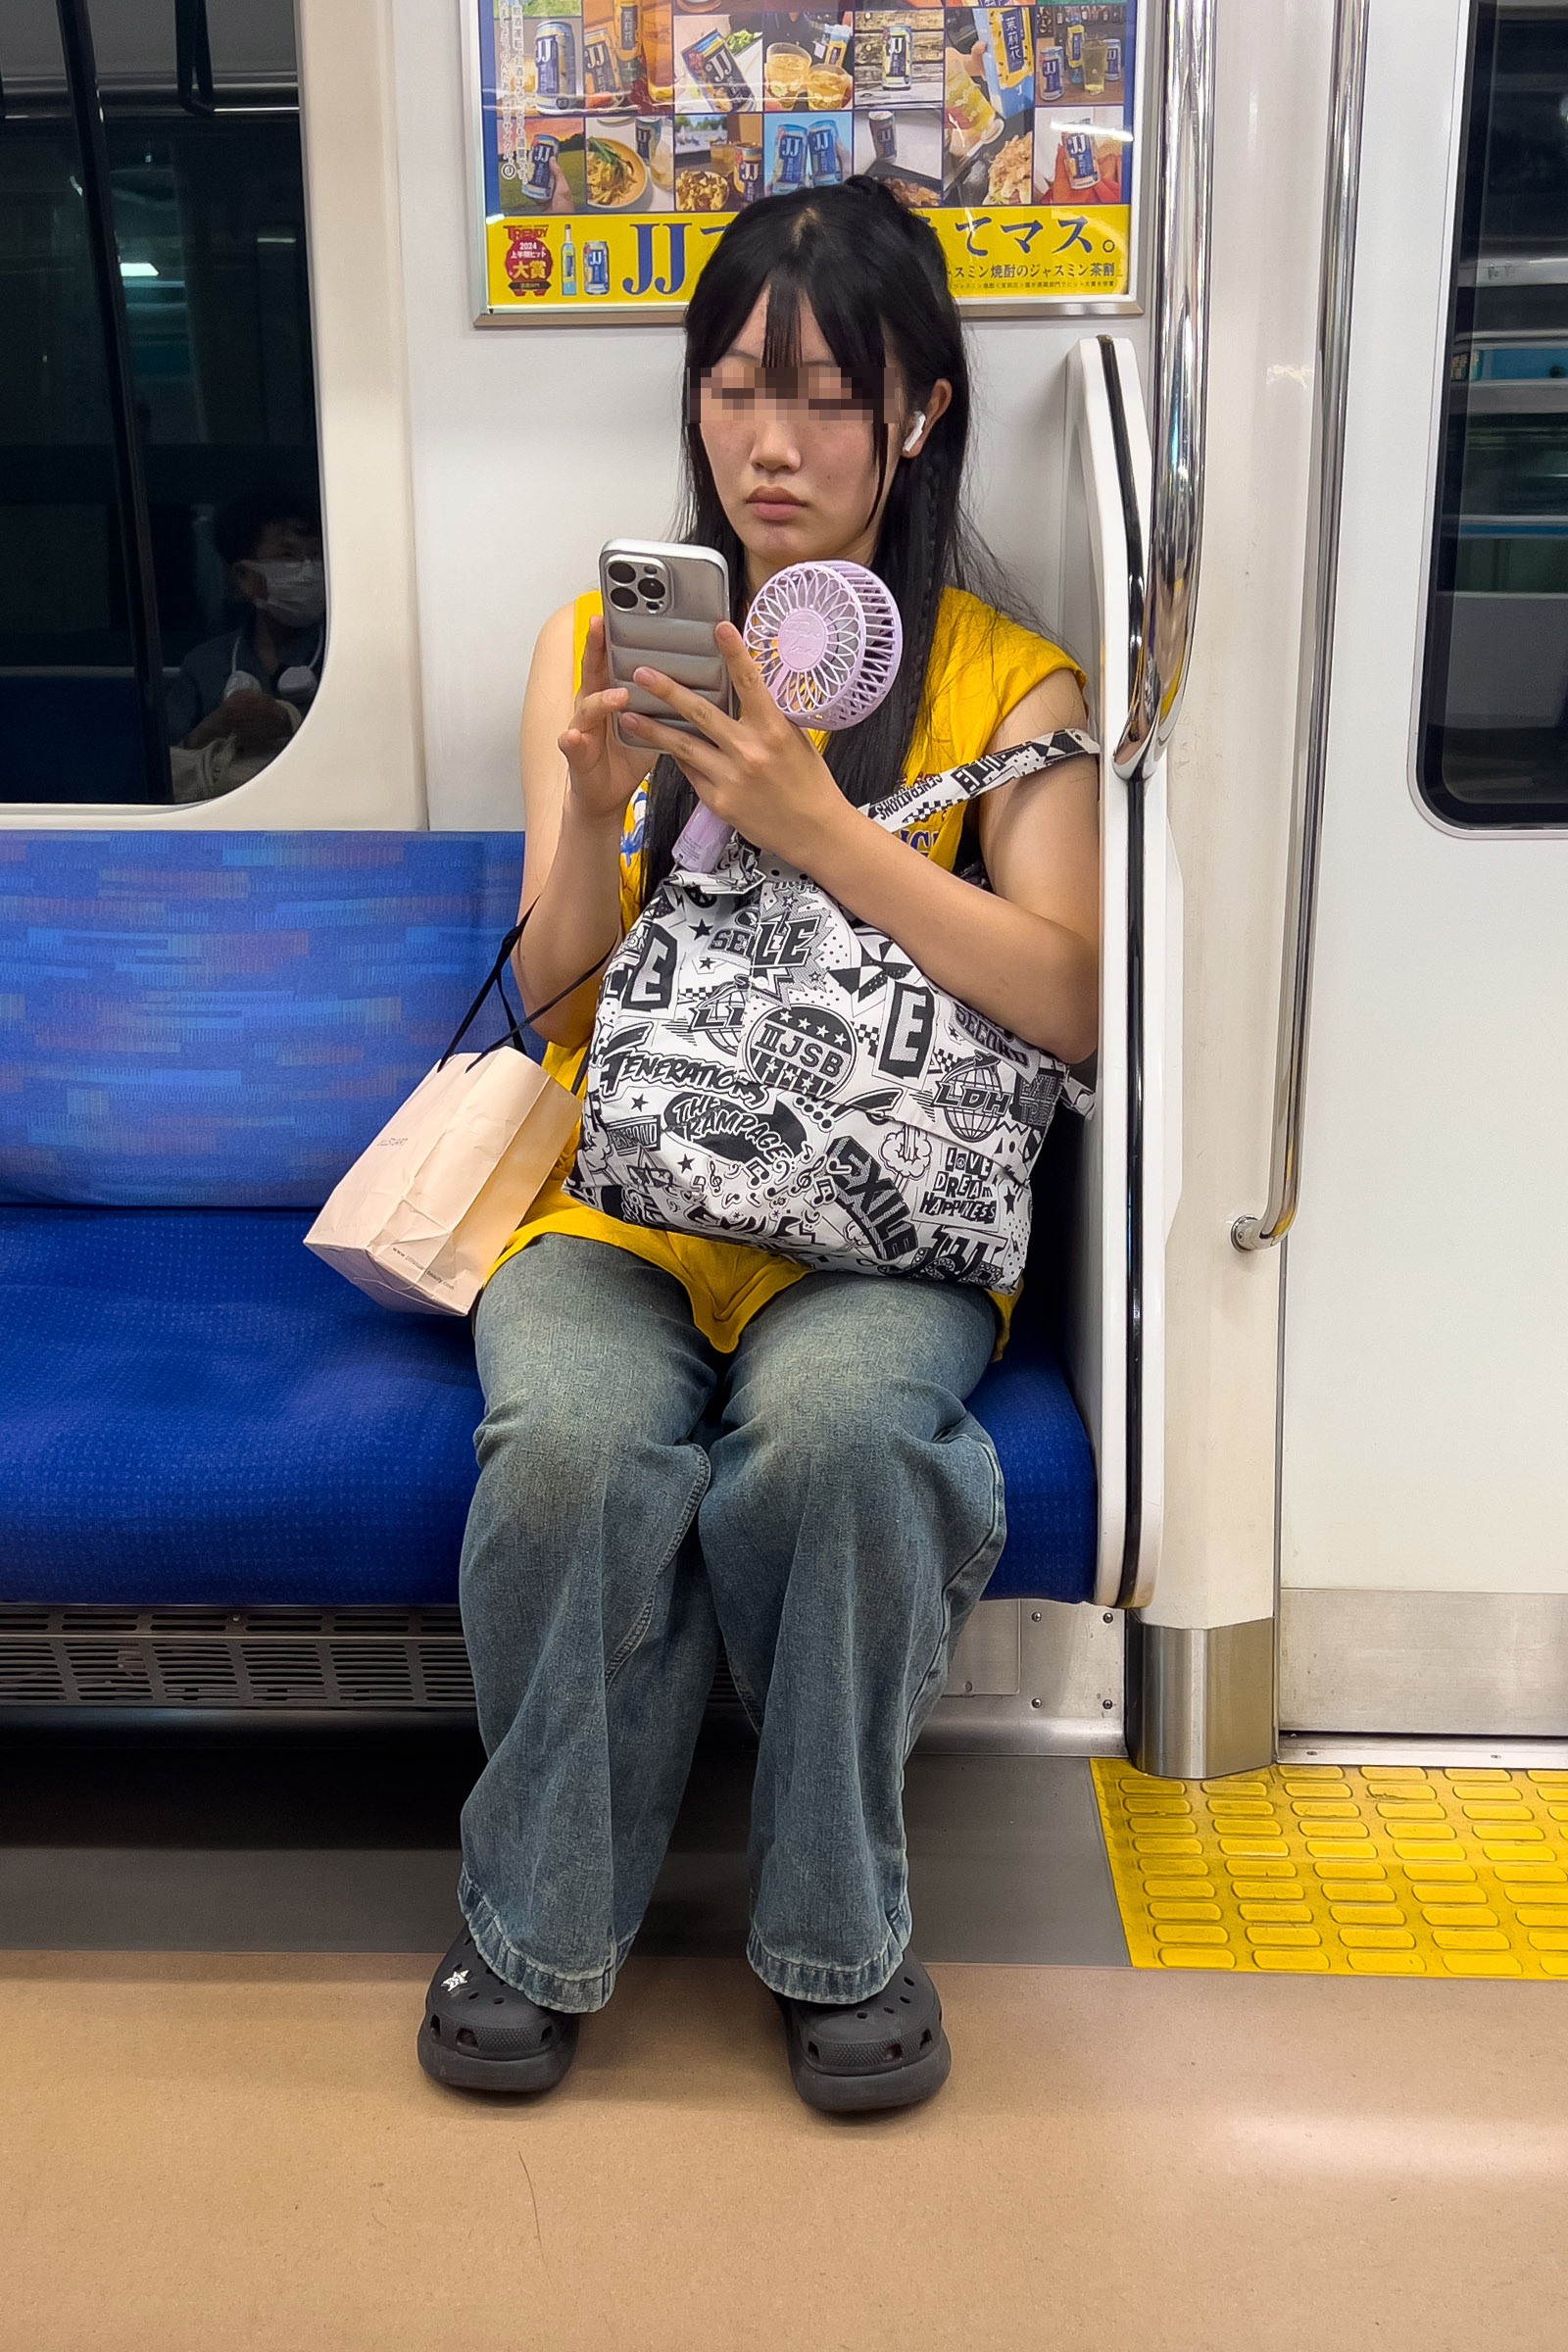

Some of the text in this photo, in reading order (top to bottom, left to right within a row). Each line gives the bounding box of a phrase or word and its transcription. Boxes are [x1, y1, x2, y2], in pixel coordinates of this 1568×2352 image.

[1004, 16, 1022, 61] 茉莉花
[519, 241, 537, 250] 2024
[622, 215, 1115, 296] JJ てマス。
[513, 260, 547, 279] 大賞
[932, 1080, 1013, 1117] LDH
[684, 1108, 797, 1164] RAMPAGE
[945, 1147, 994, 1180] LOVE
[826, 1135, 919, 1261] EXILE
[918, 1191, 999, 1225] HAPPINESS
